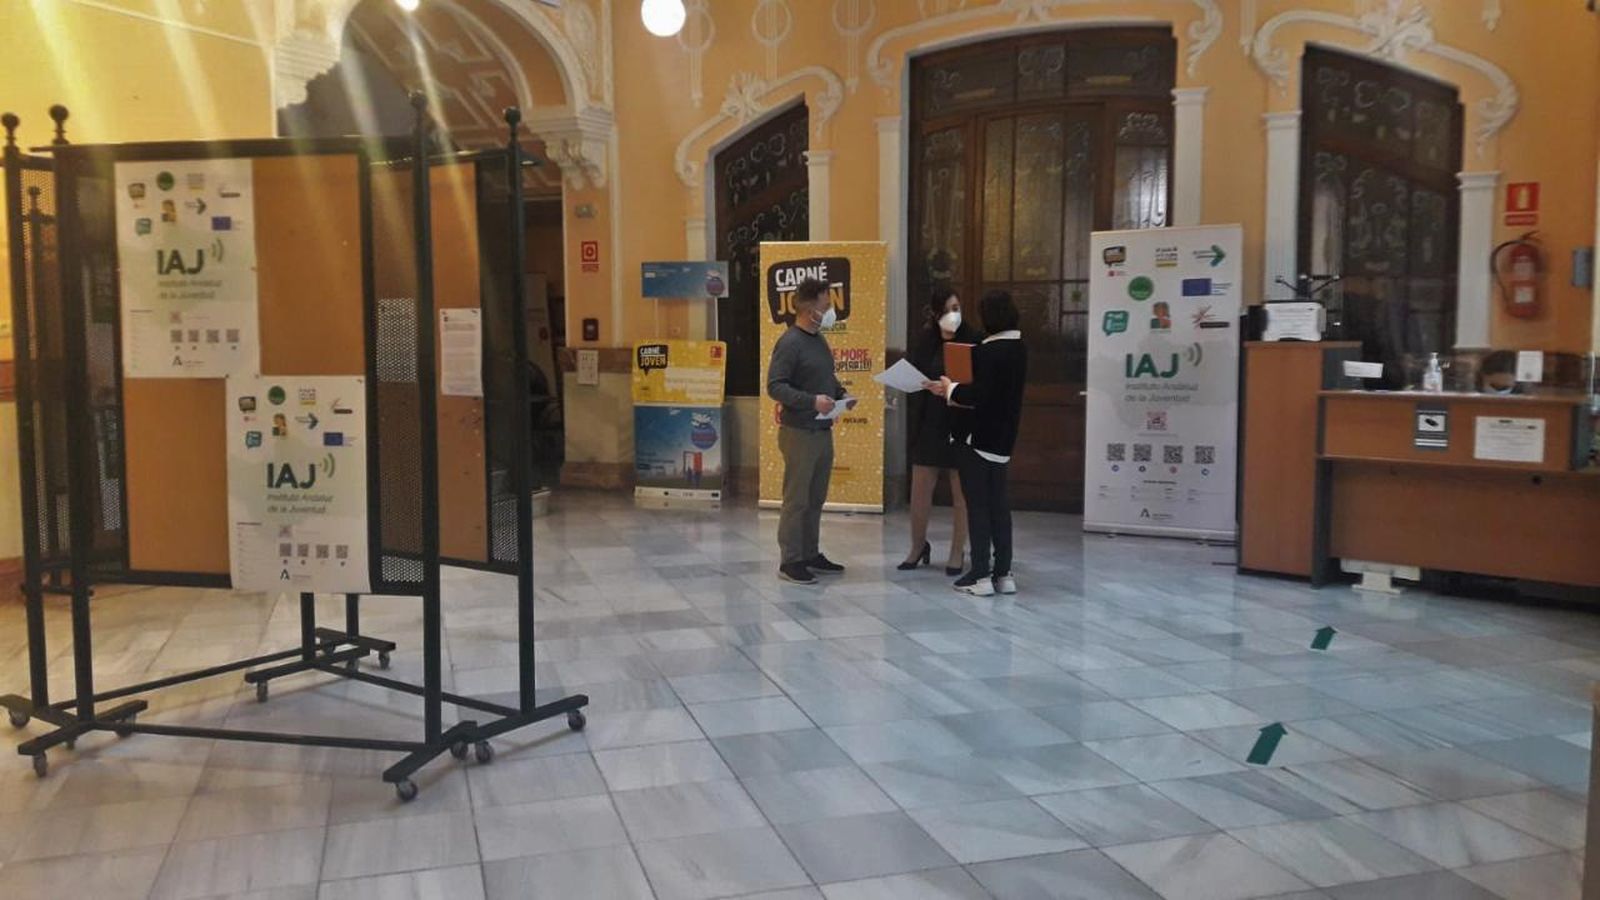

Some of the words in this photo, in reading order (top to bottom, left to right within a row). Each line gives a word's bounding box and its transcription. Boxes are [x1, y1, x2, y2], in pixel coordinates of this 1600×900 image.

[157, 249, 204, 275] IAJ
[775, 262, 828, 287] CARNÉ
[640, 355, 667, 367] JOVEN
[1125, 353, 1179, 378] IAJ
[267, 463, 316, 489] IAJ
